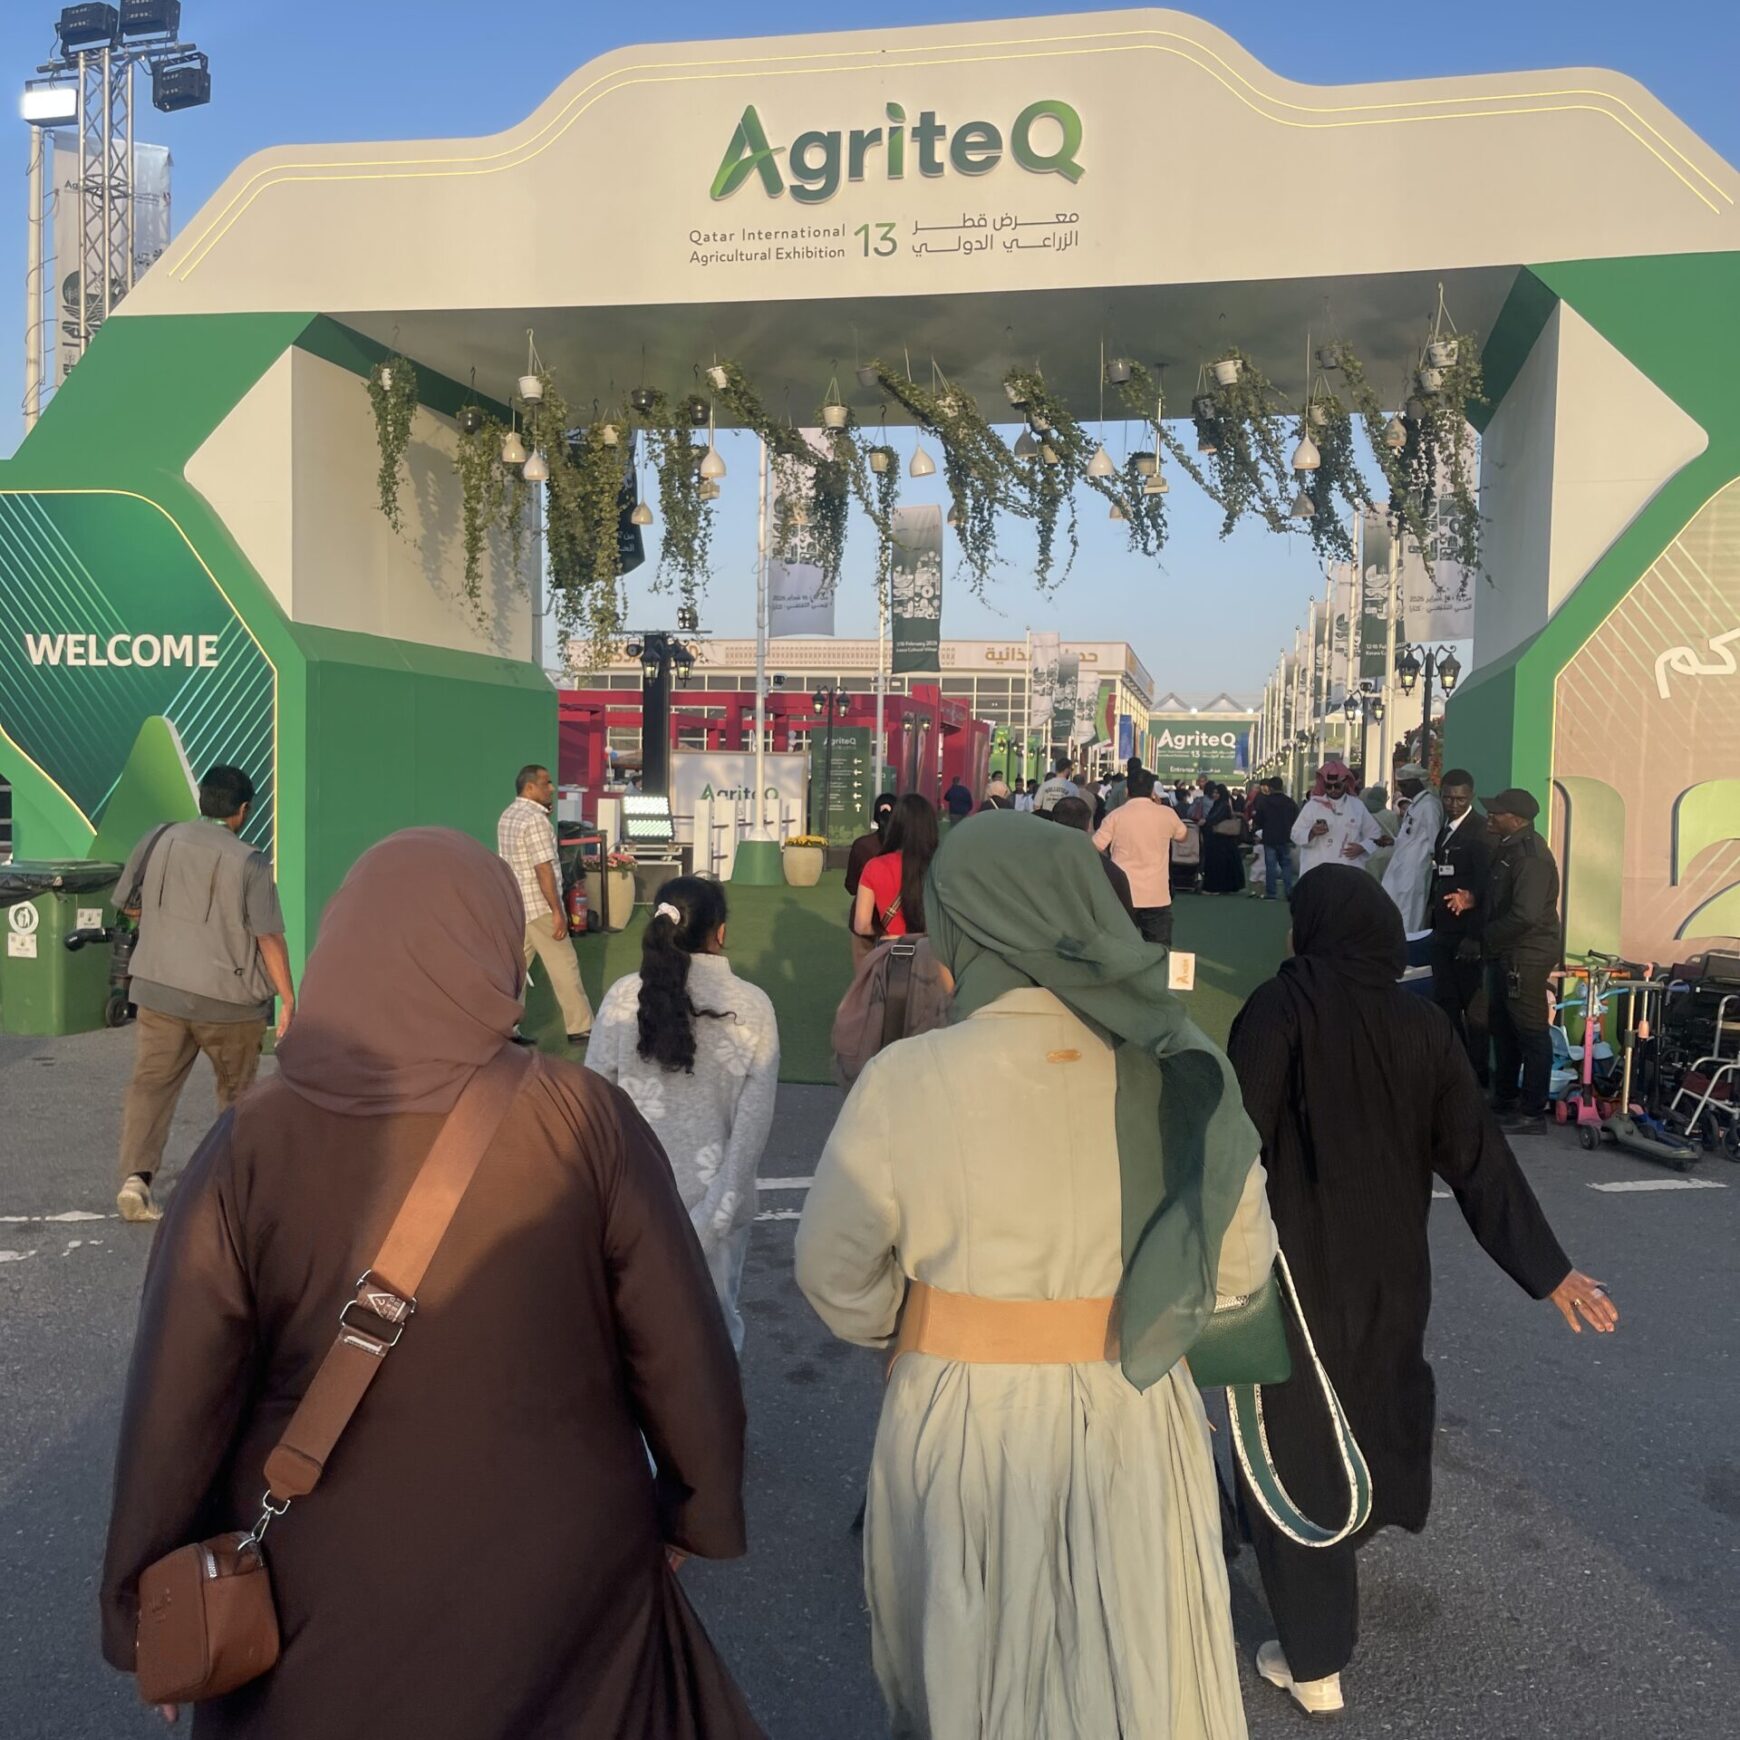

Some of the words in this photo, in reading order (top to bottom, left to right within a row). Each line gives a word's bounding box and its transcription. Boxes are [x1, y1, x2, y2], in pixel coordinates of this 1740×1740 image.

[709, 99, 1086, 205] AgriteQ
[689, 229, 734, 245] Qatar
[742, 223, 846, 241] International
[912, 211, 988, 236] قطر
[853, 222, 898, 258] 13
[912, 233, 993, 257] الدولي
[1001, 231, 1080, 254] الزراعي
[689, 247, 771, 266] Agricultural
[775, 245, 846, 261] Exhibition
[25, 633, 220, 668] WELCOME
[1158, 728, 1236, 750] AgriteQ
[1190, 750, 1201, 758] 13
